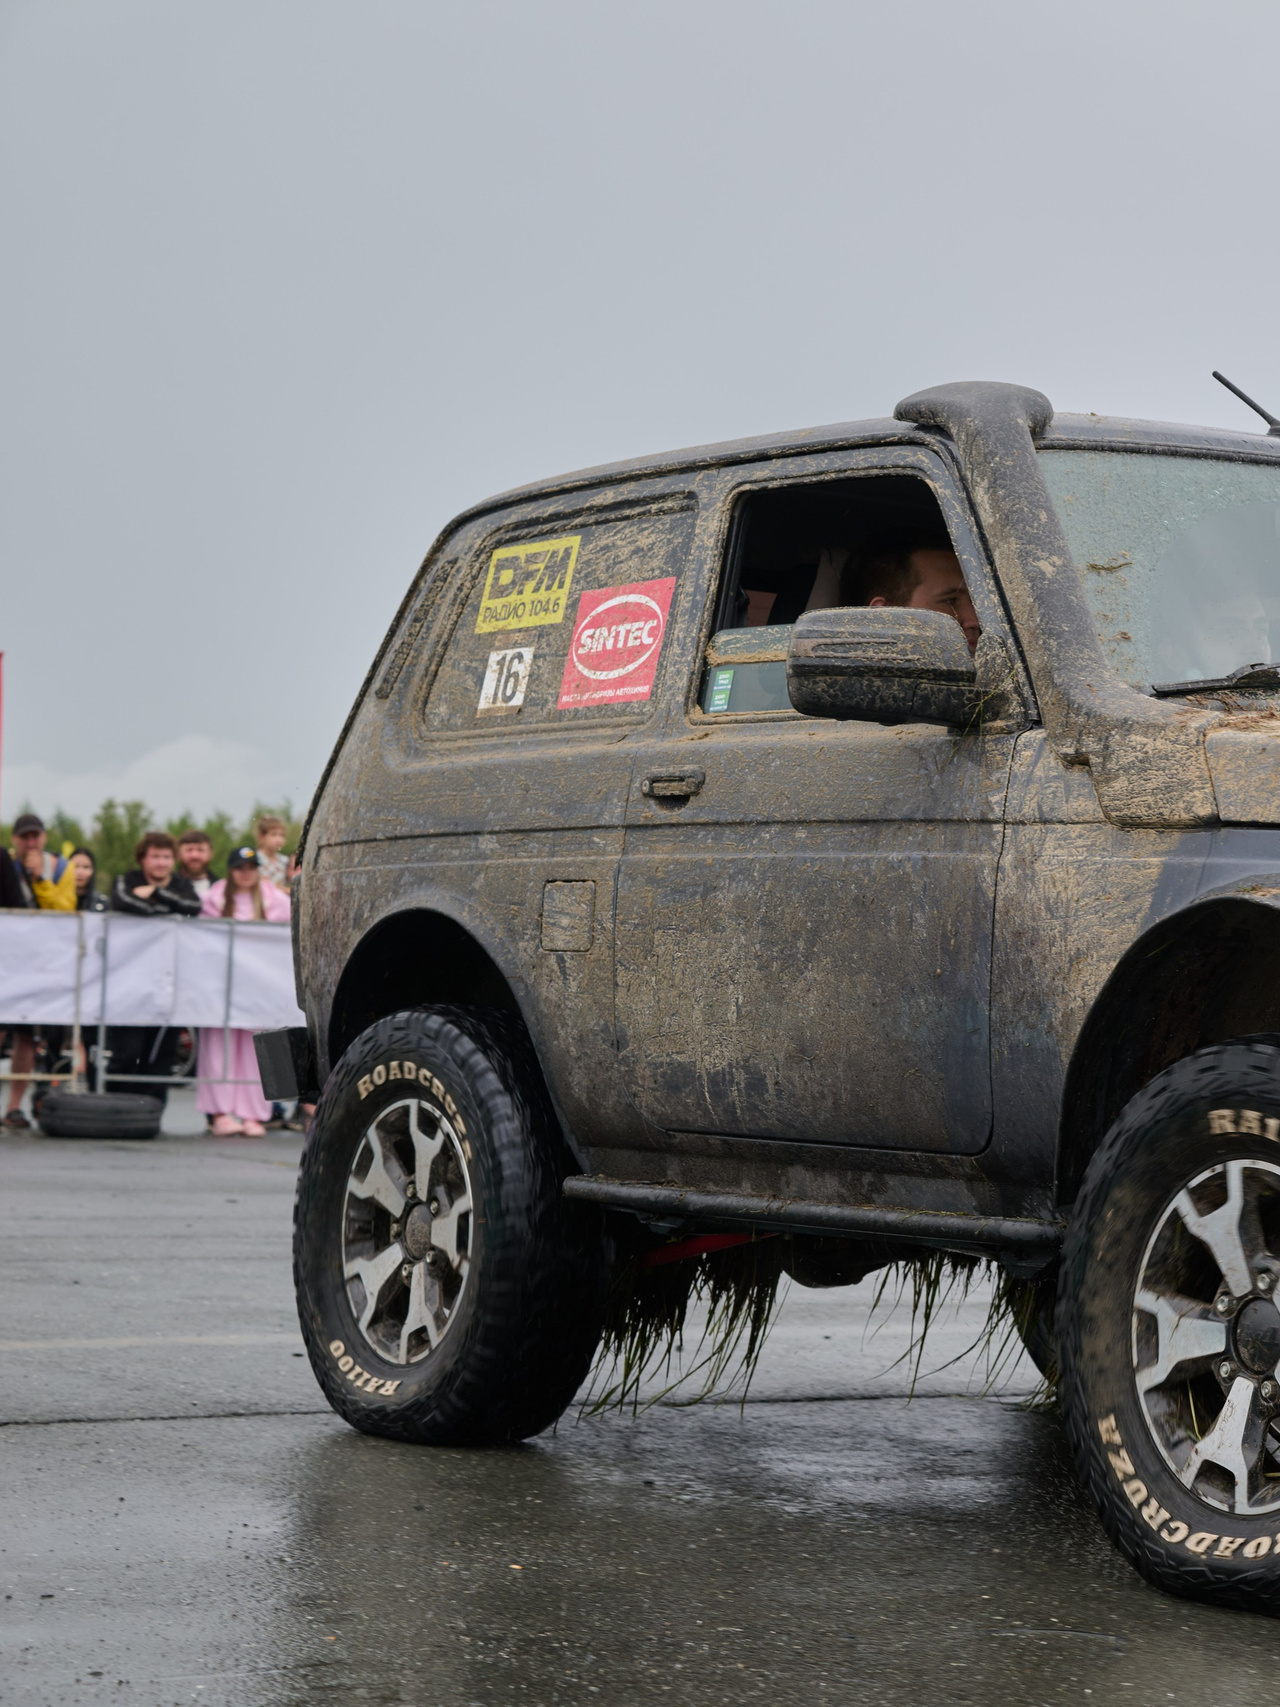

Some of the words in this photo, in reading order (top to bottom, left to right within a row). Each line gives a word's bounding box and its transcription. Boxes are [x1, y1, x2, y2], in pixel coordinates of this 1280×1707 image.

[487, 546, 573, 600] DFM
[482, 602, 527, 623] РАДИО
[577, 619, 657, 655] SINTEC
[491, 651, 524, 705] 16
[329, 1339, 403, 1396] RA1100
